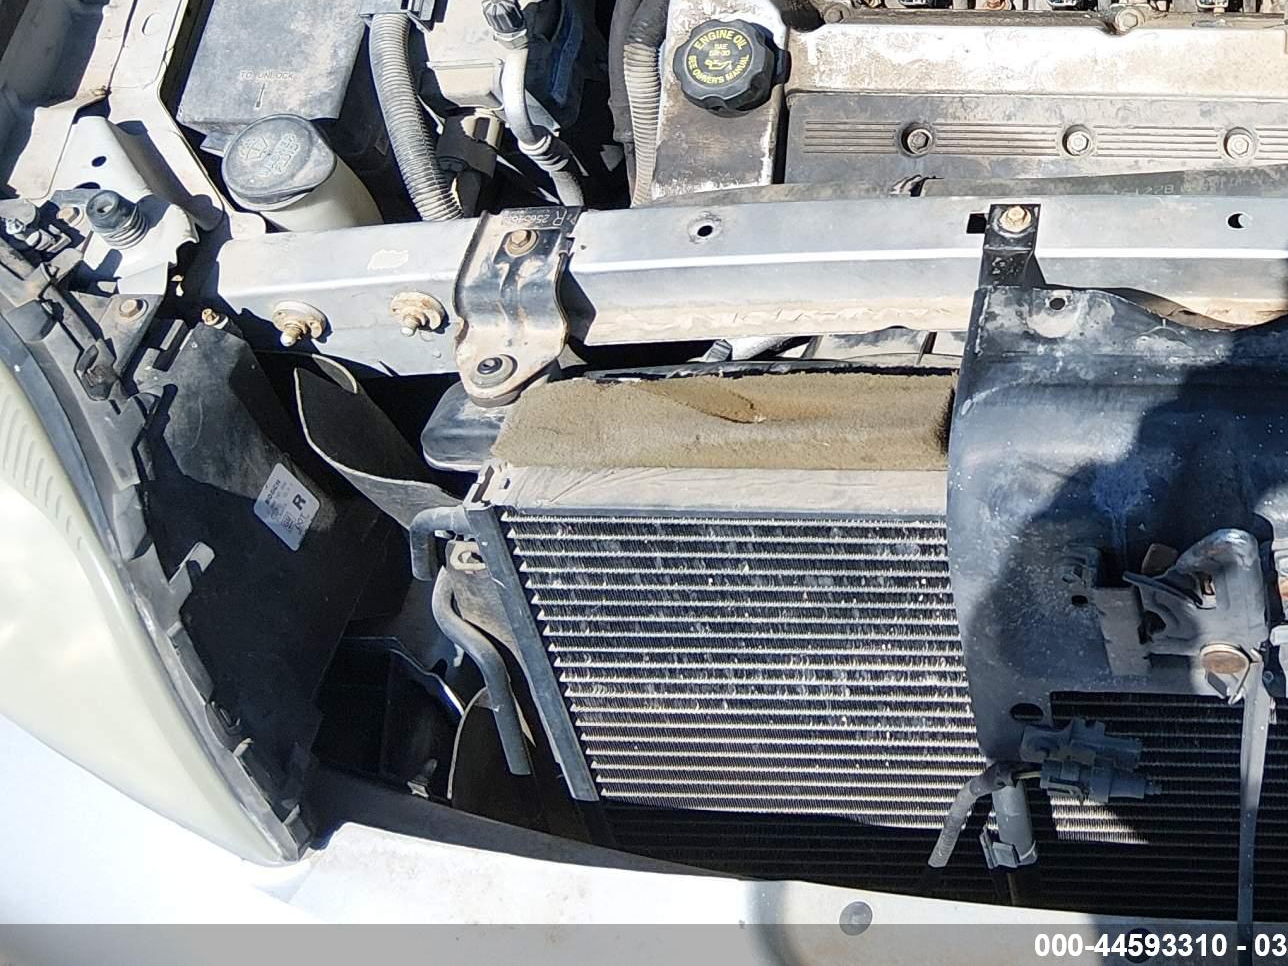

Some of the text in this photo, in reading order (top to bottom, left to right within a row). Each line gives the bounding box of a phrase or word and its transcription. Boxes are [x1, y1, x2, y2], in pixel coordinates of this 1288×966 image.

[693, 29, 747, 50] ENGINE OIL
[725, 55, 749, 81] MANUAL
[264, 480, 281, 505] BOSCH
[292, 494, 306, 511] R
